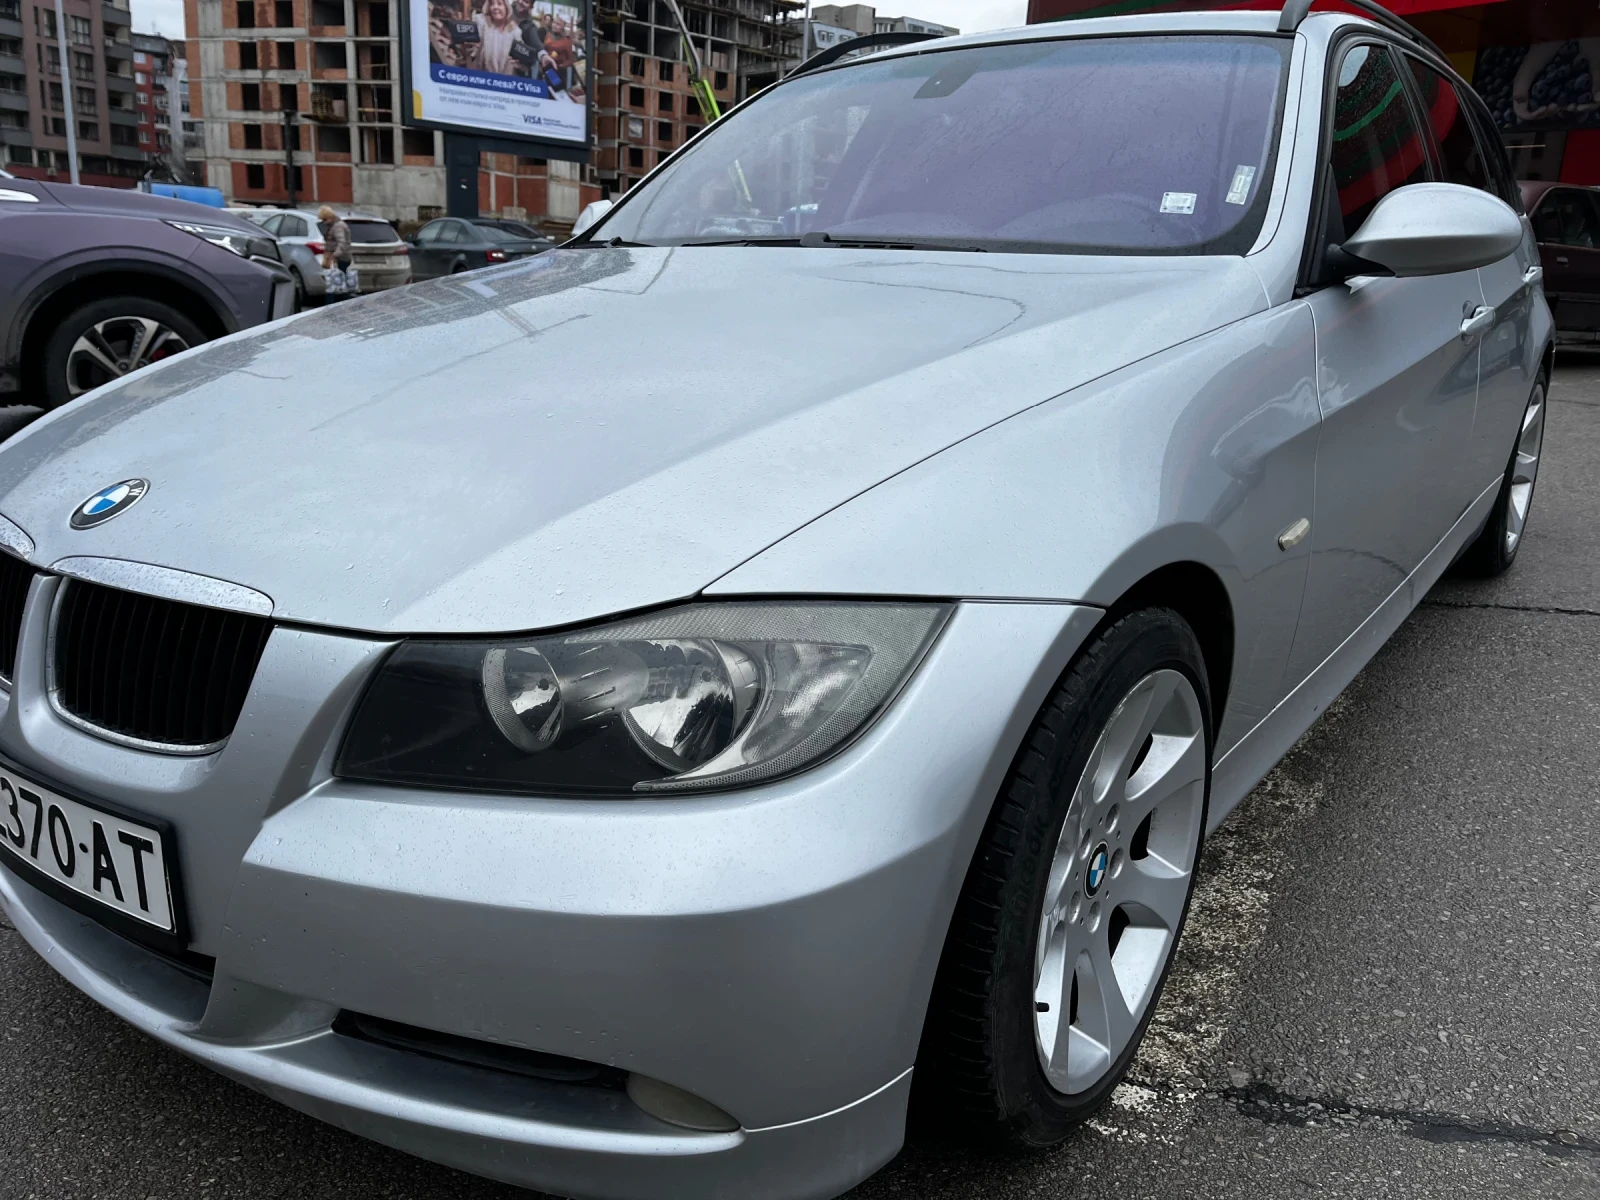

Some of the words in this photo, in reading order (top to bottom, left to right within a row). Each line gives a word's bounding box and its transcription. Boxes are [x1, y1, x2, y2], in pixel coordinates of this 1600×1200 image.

[456, 24, 475, 33] ЕВРО
[446, 72, 469, 83] евро
[469, 76, 485, 85] или
[492, 80, 517, 90] лева?
[524, 83, 542, 94] Visa
[523, 114, 542, 125] VISA
